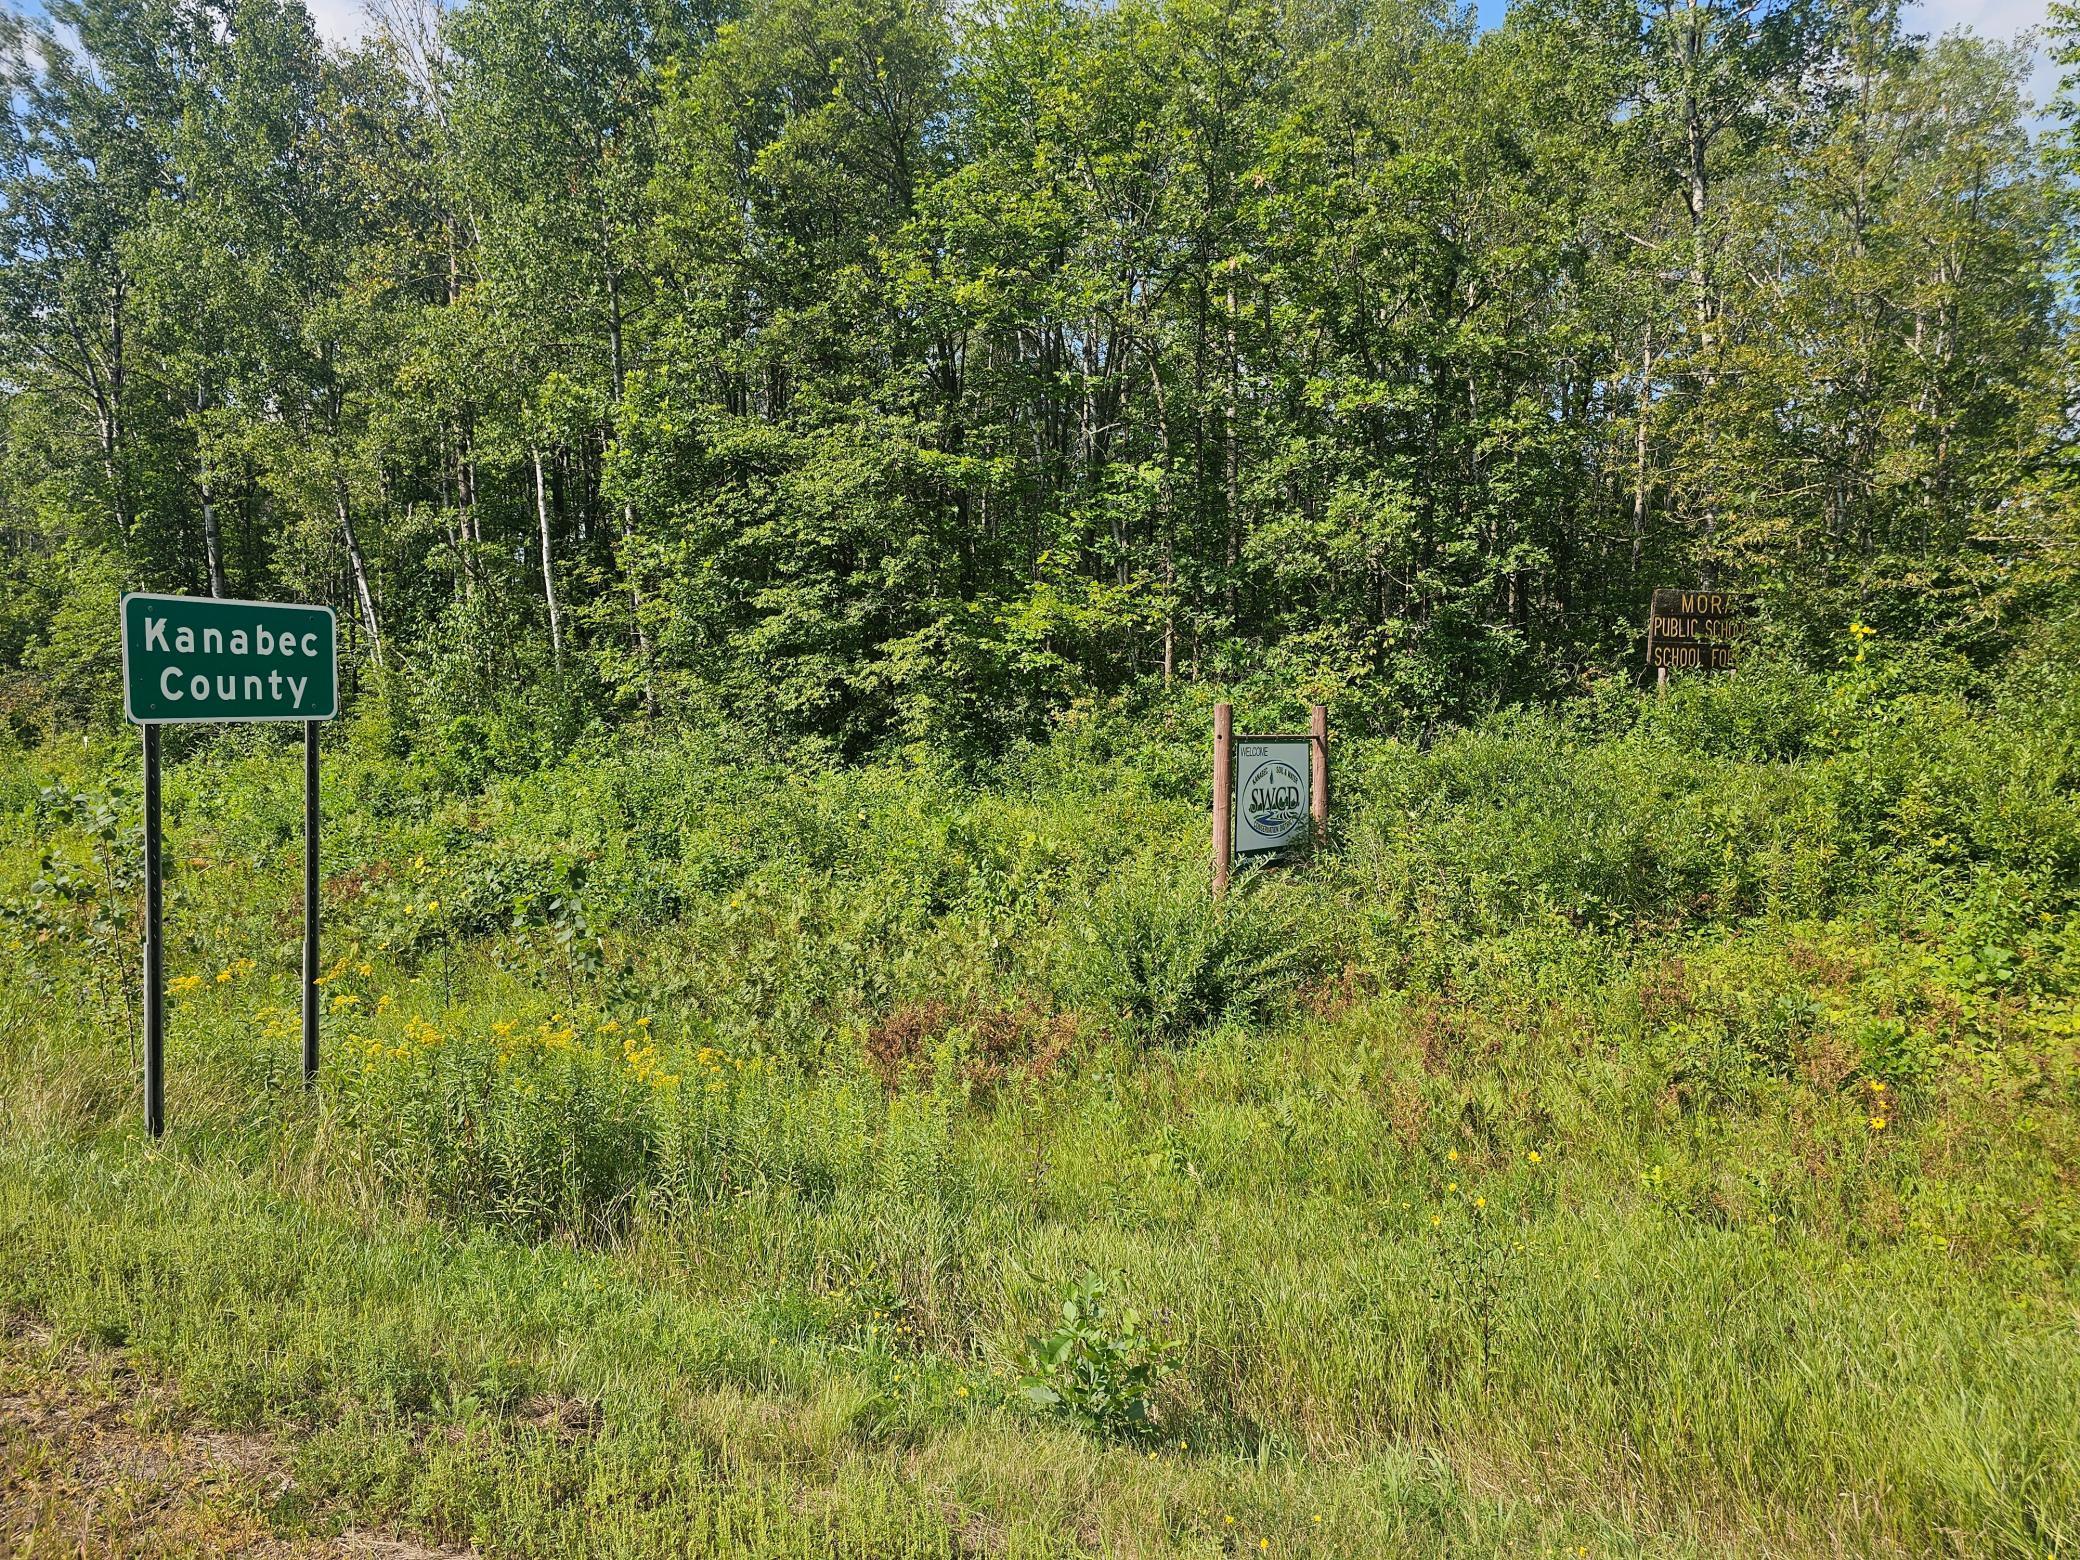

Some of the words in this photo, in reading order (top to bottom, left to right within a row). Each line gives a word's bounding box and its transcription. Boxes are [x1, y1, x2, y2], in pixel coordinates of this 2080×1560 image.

[144, 617, 319, 657] Kanabec
[1653, 616, 1698, 638] PUBLIC
[1654, 646, 1701, 667] SCHOOL
[160, 666, 308, 709] County
[1240, 747, 1268, 757] WELCOME
[1249, 786, 1299, 814] SWCD
